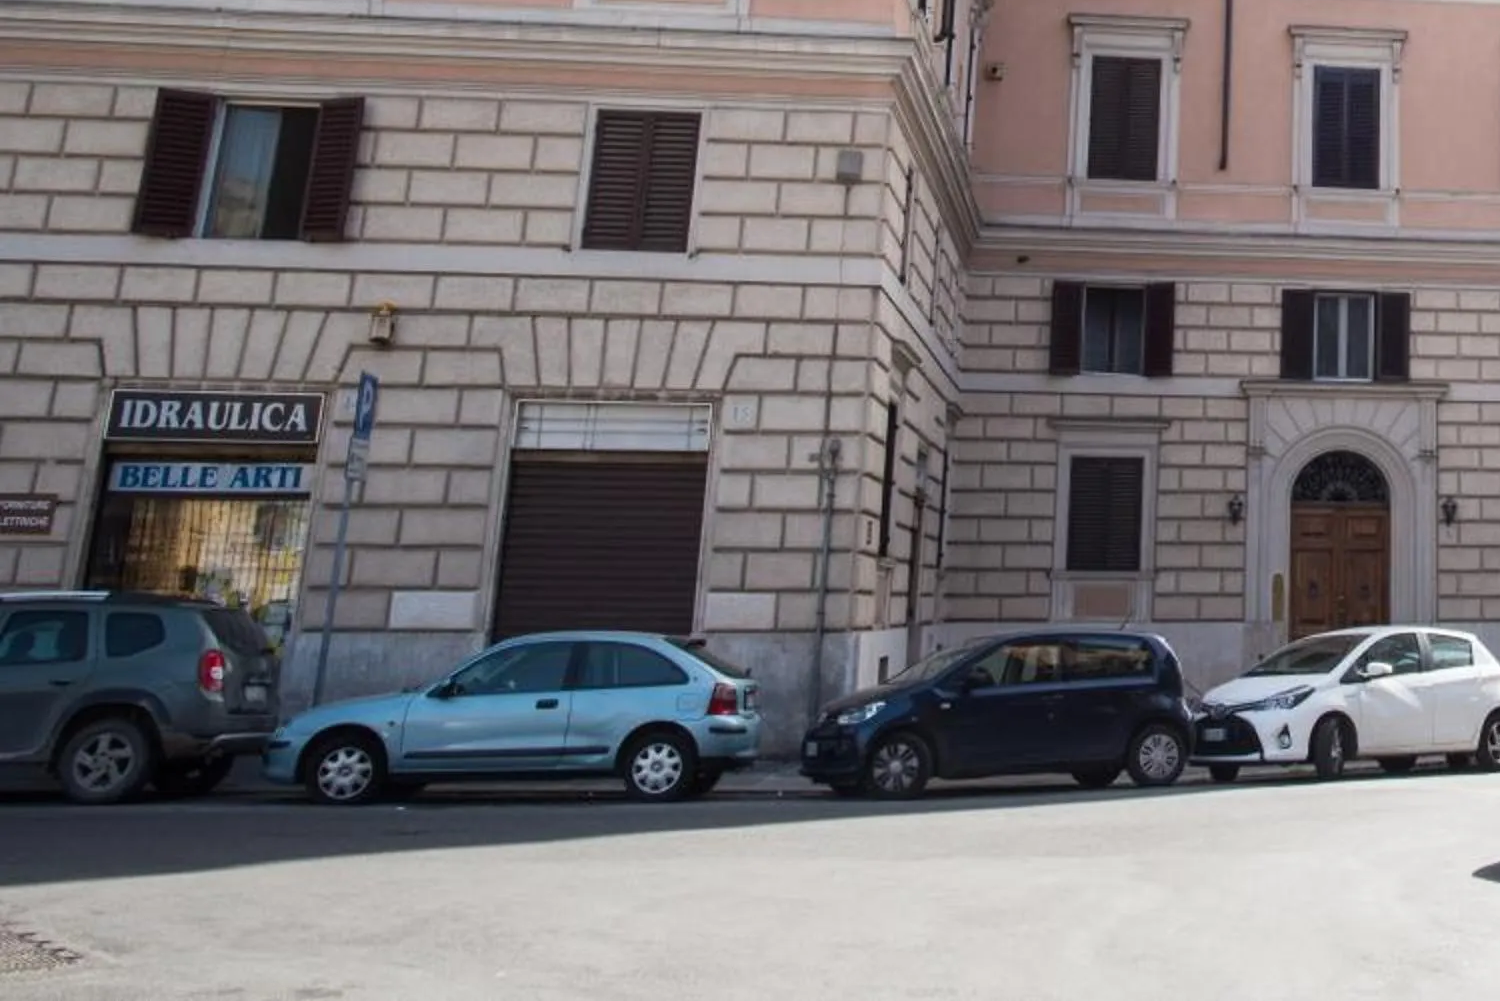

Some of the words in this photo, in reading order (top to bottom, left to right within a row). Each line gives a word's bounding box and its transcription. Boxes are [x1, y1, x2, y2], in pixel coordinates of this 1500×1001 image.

[118, 399, 308, 431] IDRAULICA
[359, 379, 374, 430] P
[118, 465, 219, 489] BELLE
[229, 466, 304, 489] ARTI
[0, 500, 51, 510] ORNITURE
